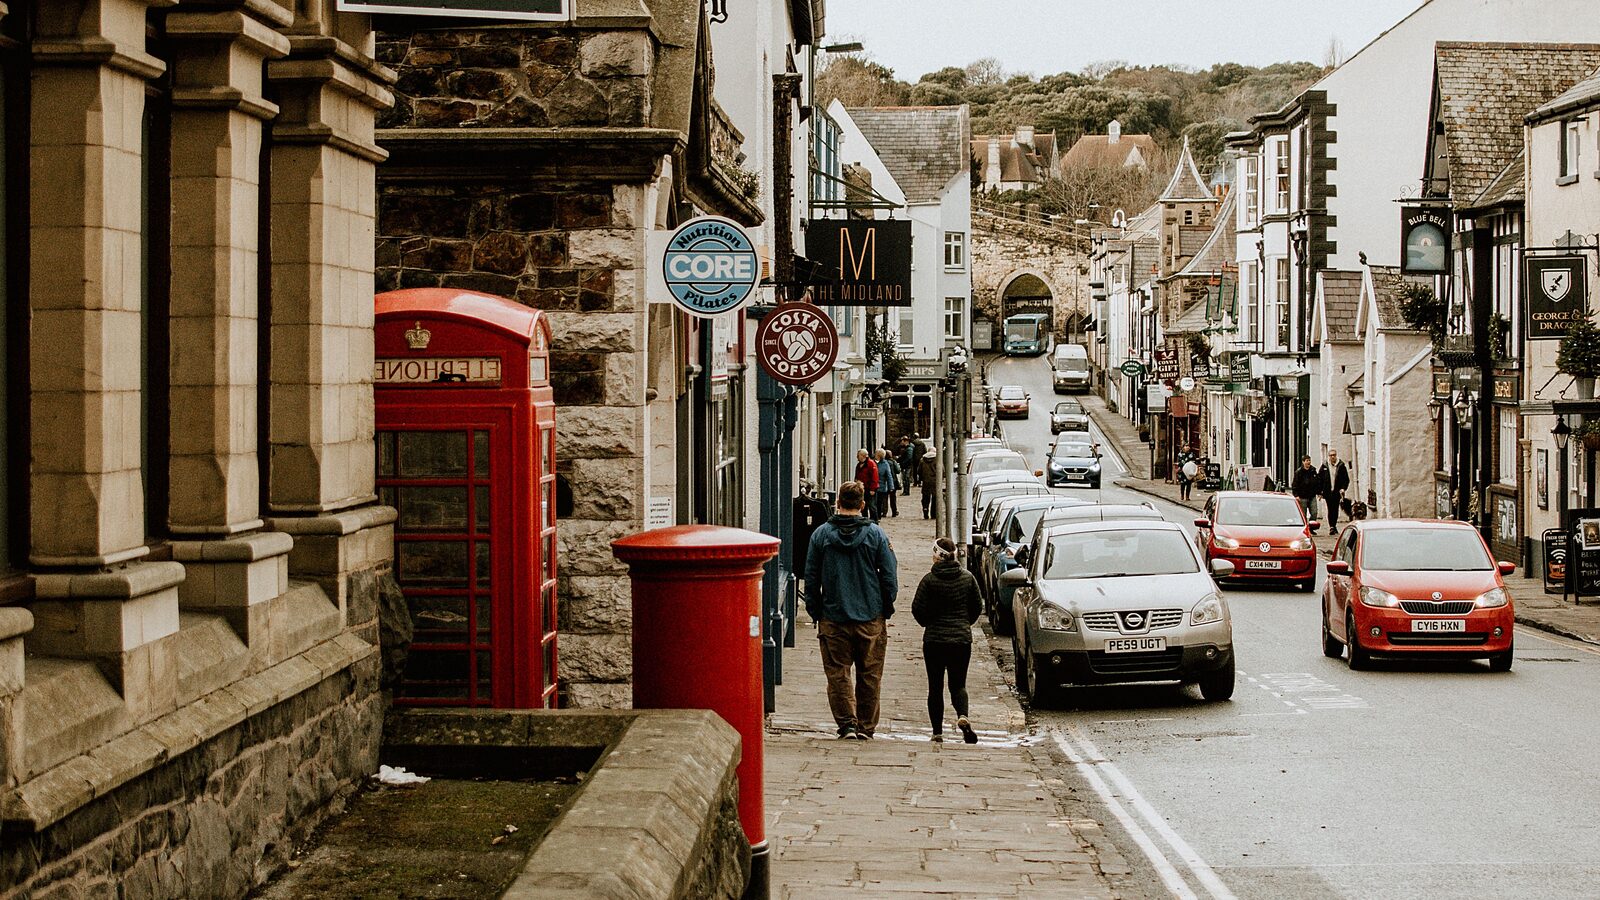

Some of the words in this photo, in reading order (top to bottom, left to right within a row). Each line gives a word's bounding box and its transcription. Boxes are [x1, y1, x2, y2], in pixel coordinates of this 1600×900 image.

[1408, 214, 1427, 226] BLUE
[1429, 215, 1446, 227] BELL
[676, 224, 741, 248] Nutrition
[841, 228, 875, 280] M
[669, 254, 751, 279] CORE
[683, 290, 737, 308] Pilates
[842, 284, 902, 301] MIDLAND
[772, 312, 820, 332] COSTA
[1532, 312, 1570, 320] GEORGE
[1540, 322, 1574, 330] DRAGO
[769, 351, 827, 376] COFFEE
[1417, 621, 1438, 630] CY16
[1441, 621, 1459, 630] HXN
[1109, 640, 1138, 651] PE59
[1140, 639, 1161, 649] UGT
